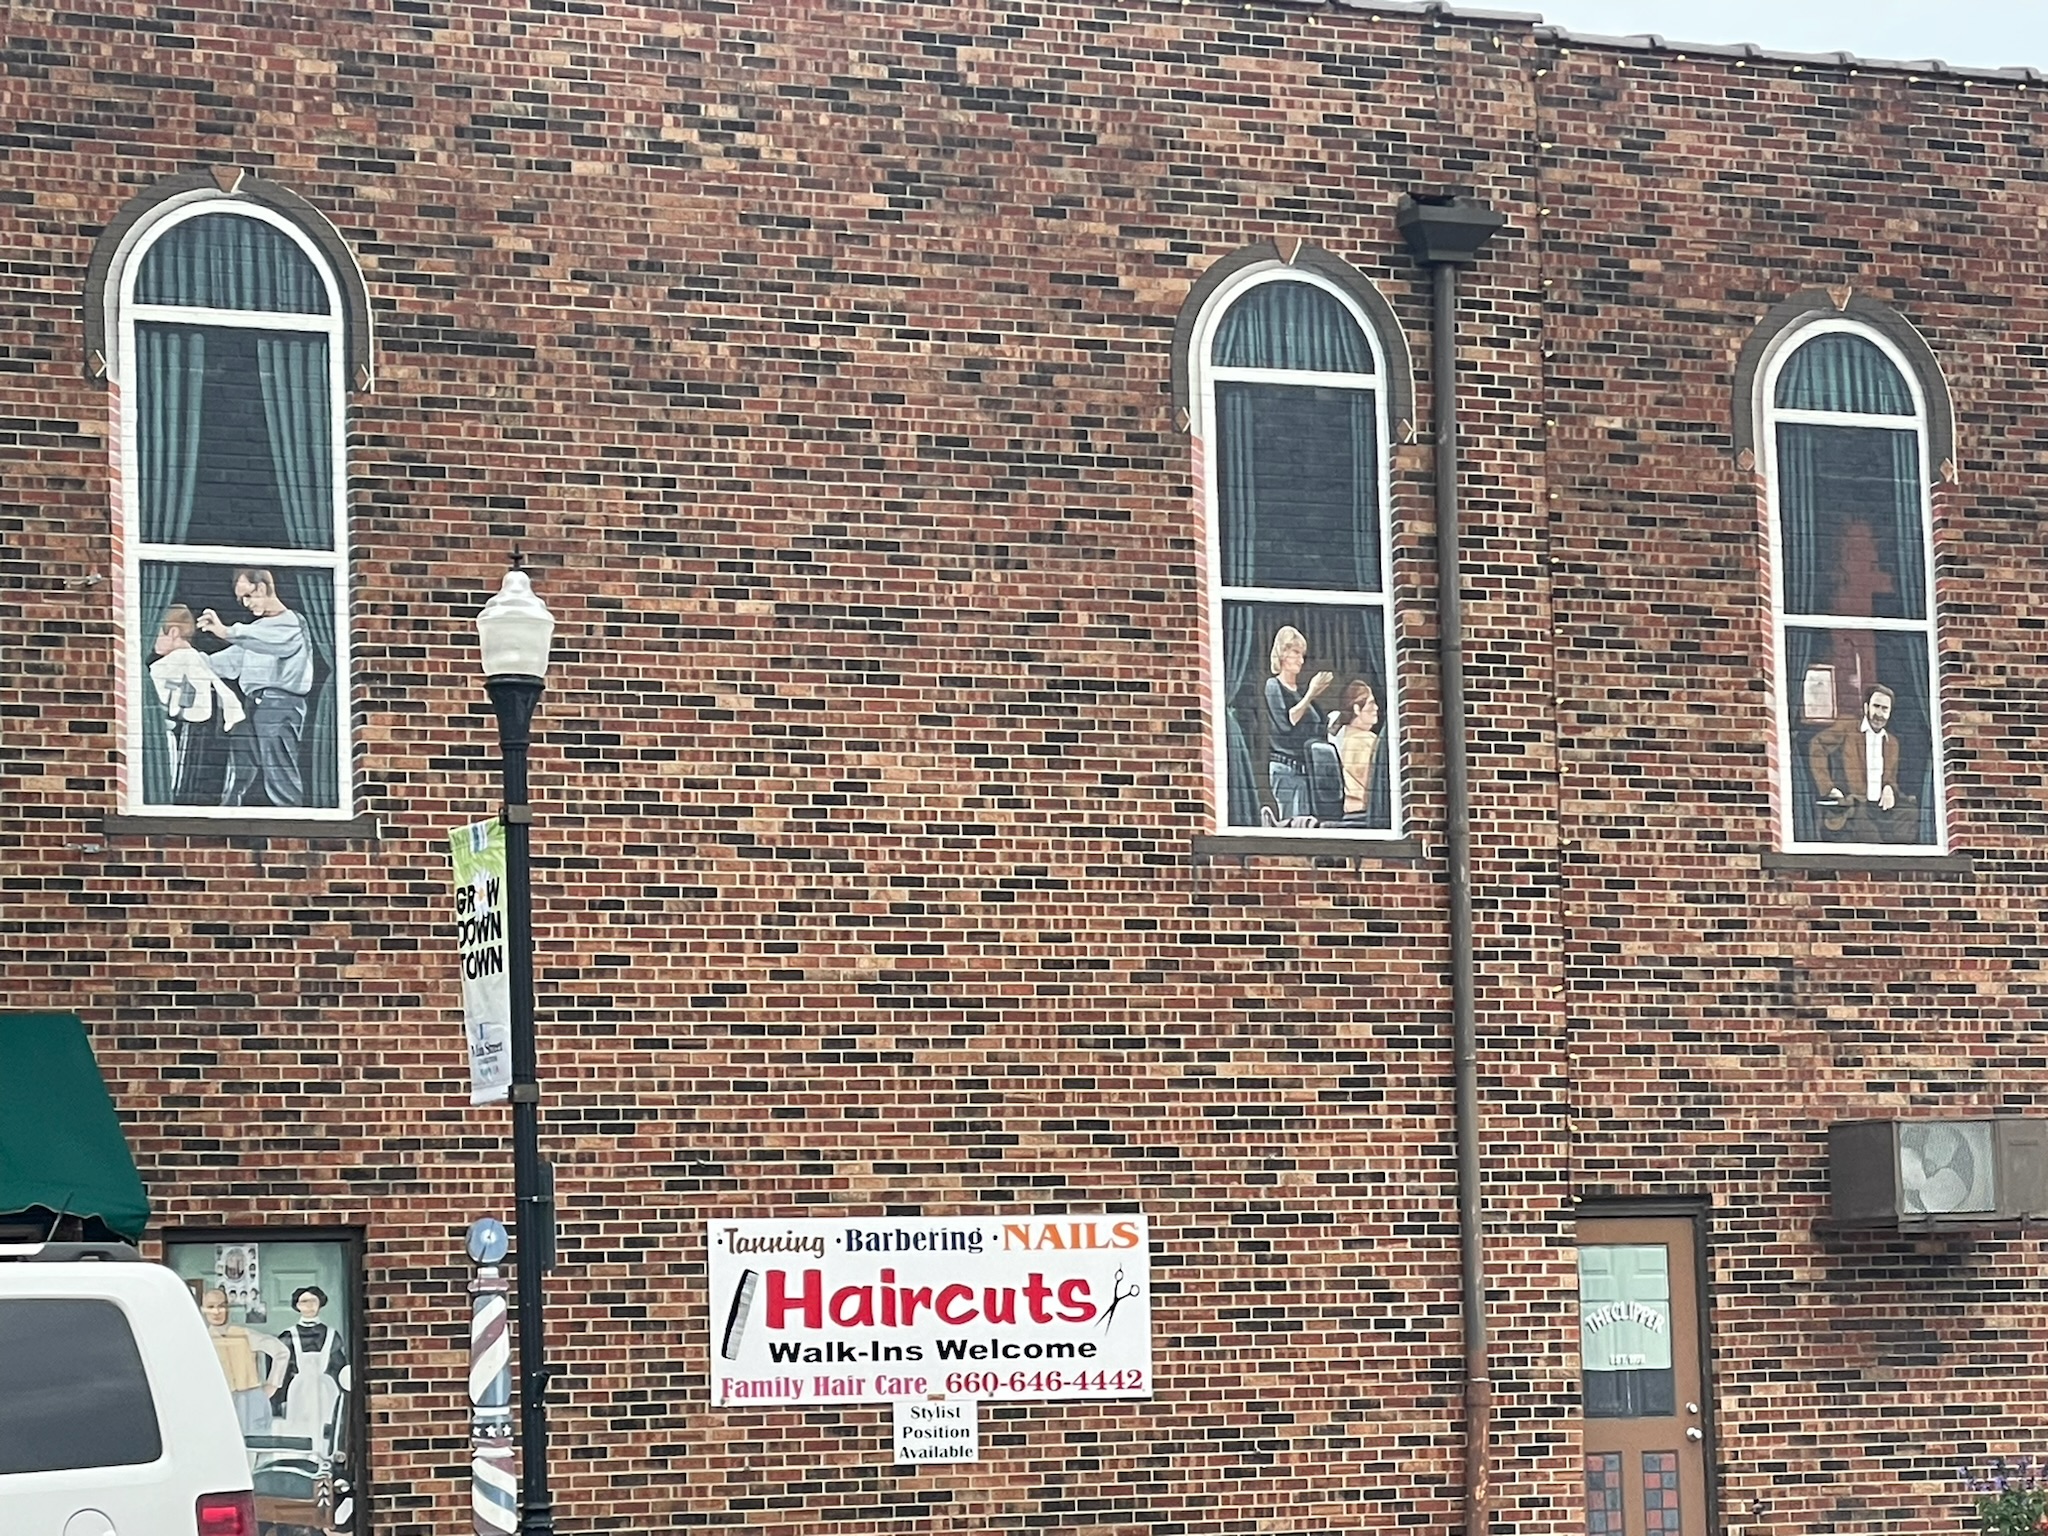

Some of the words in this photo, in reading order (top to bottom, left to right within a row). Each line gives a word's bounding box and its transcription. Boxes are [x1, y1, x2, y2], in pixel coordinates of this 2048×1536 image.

[458, 910, 501, 948] DOWN
[724, 1227, 825, 1258] Tanning
[845, 1227, 983, 1253] Barbering
[1003, 1221, 1139, 1250] NAILS
[765, 1268, 1097, 1329] Haircuts
[1610, 1301, 1665, 1334] CLIPPER
[769, 1341, 923, 1363] Walk-Ins
[936, 1339, 1097, 1360] Welcome
[721, 1376, 804, 1400] Family
[813, 1375, 866, 1396] Hair
[875, 1374, 928, 1395] Care
[945, 1369, 1143, 1393] 660-646-4442
[910, 1404, 961, 1422] Stylist
[902, 1425, 970, 1439] Position
[900, 1445, 973, 1458] Available
